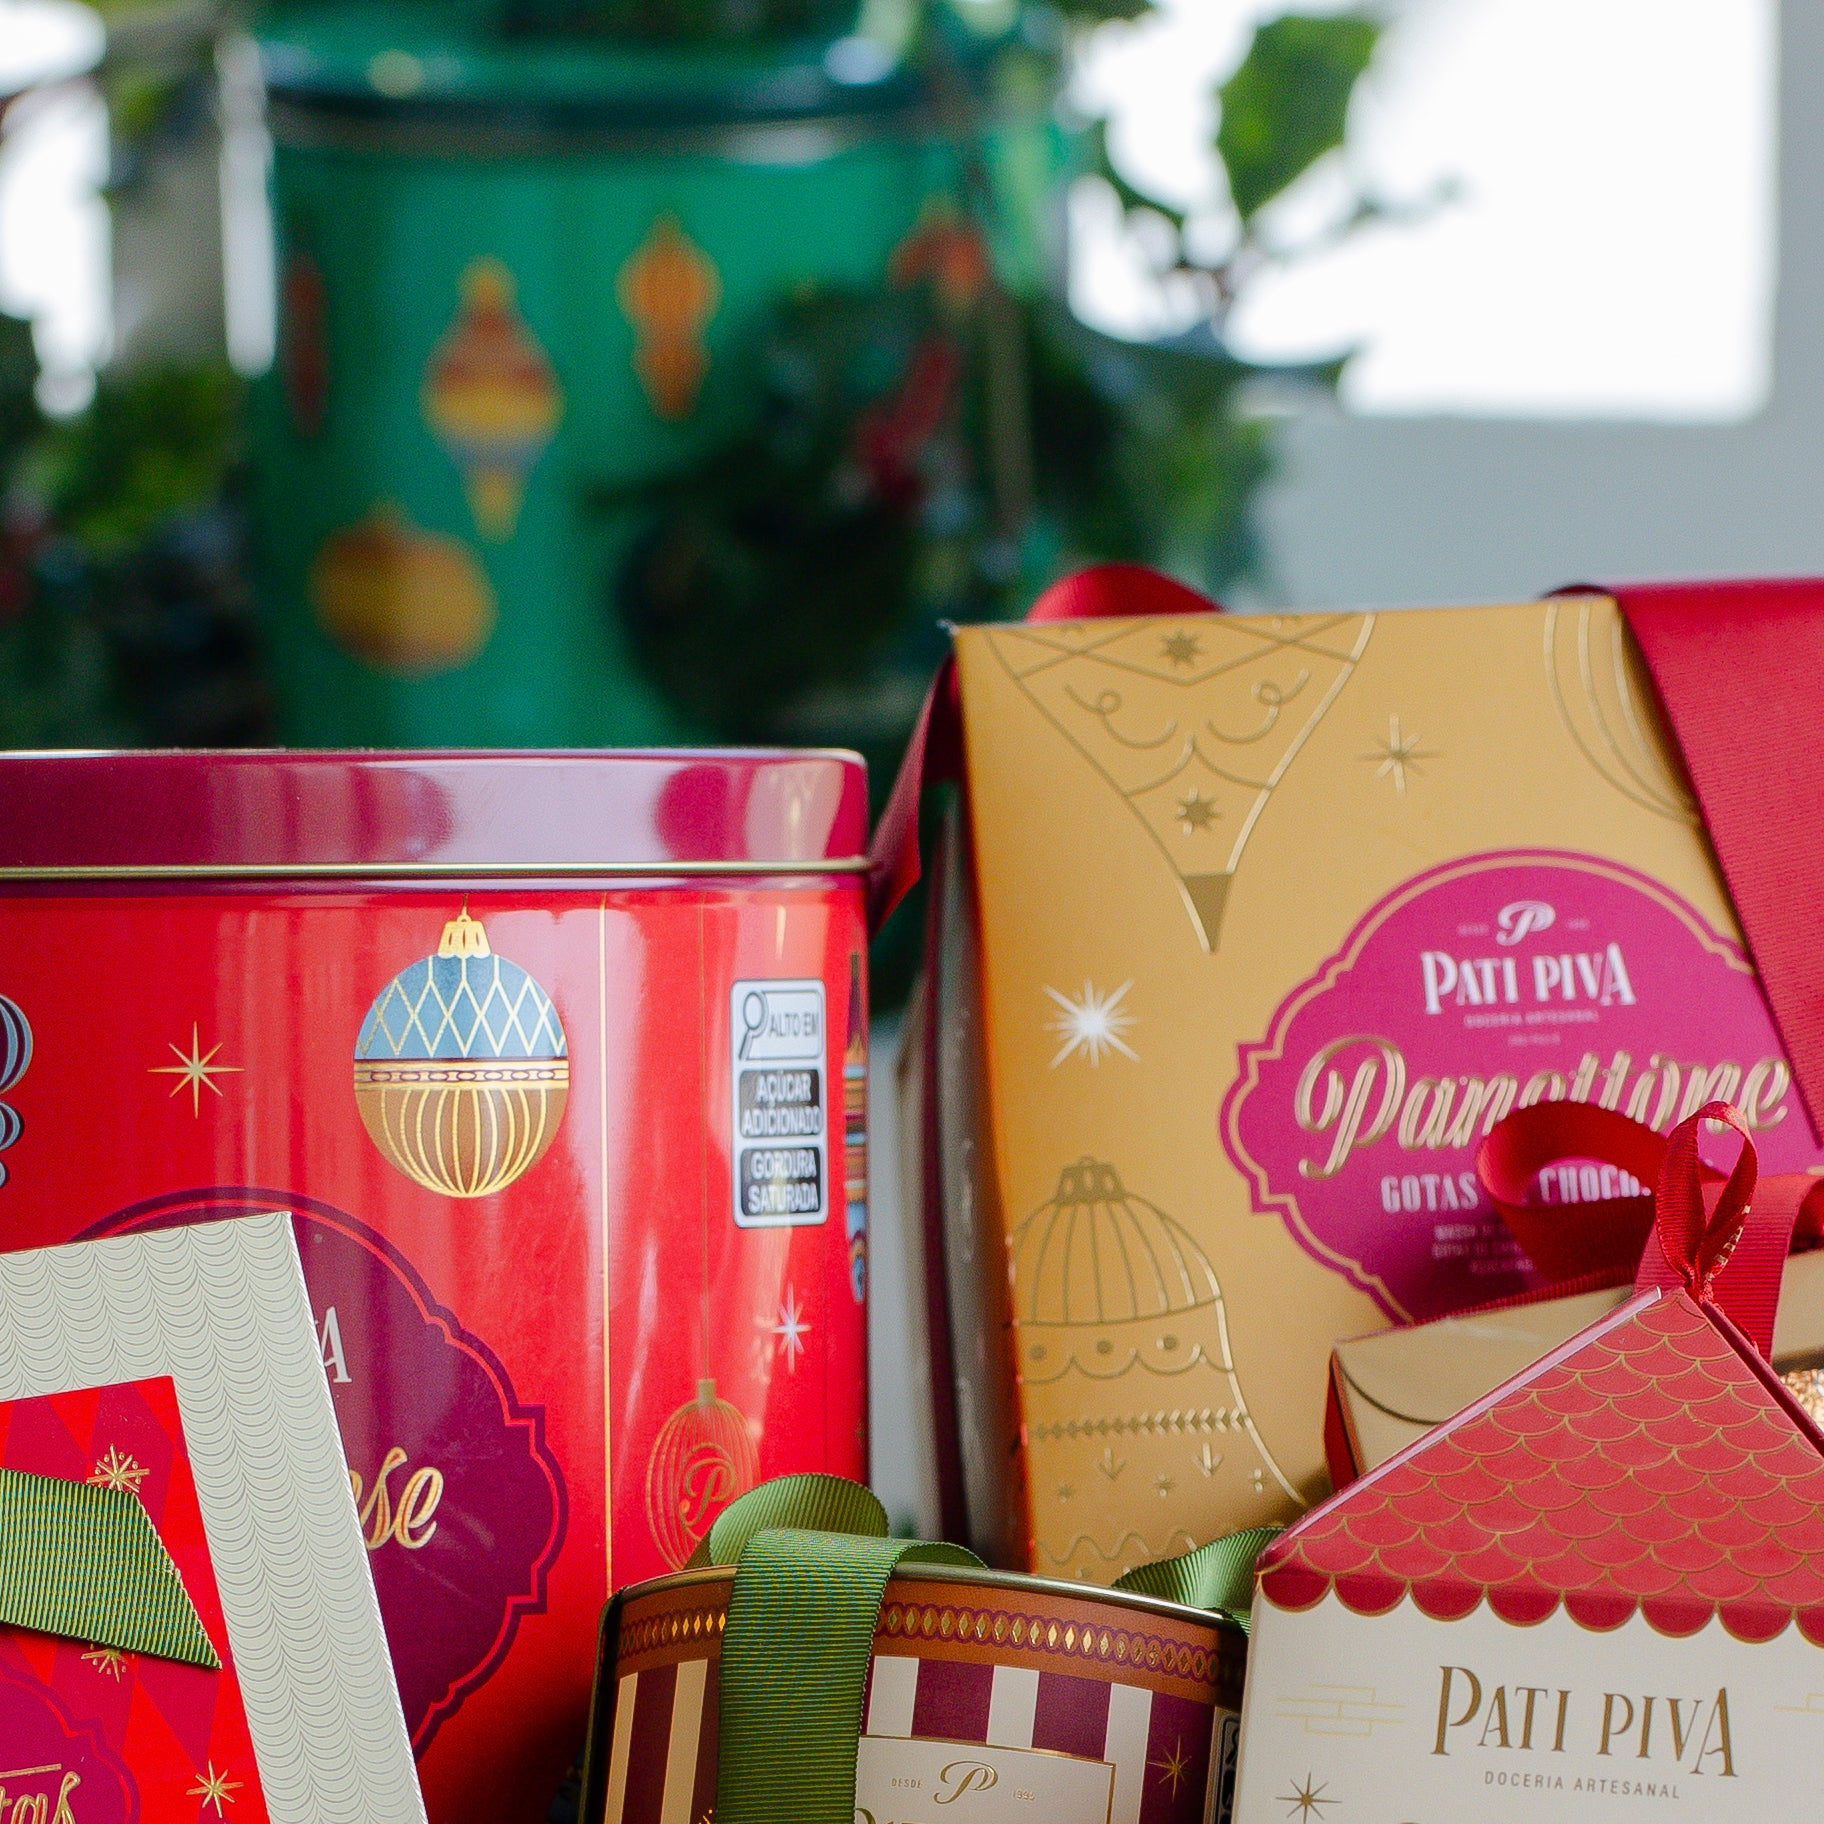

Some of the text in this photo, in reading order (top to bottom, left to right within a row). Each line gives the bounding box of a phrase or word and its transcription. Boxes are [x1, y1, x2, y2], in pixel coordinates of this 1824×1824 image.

[1420, 942, 1637, 1015] PATI PIVA
[769, 1013, 801, 1037] ALTO
[756, 1070, 812, 1107] AÇÚCAR
[741, 1106, 821, 1135] ADICIONADO
[750, 1150, 817, 1180] GORDURA
[748, 1183, 819, 1214] SATURADA
[1381, 1172, 1479, 1213] GOTAS
[1430, 1665, 1739, 1779] PATI PIVA
[1484, 1770, 1681, 1800] DOCERIA ARTESANAL
